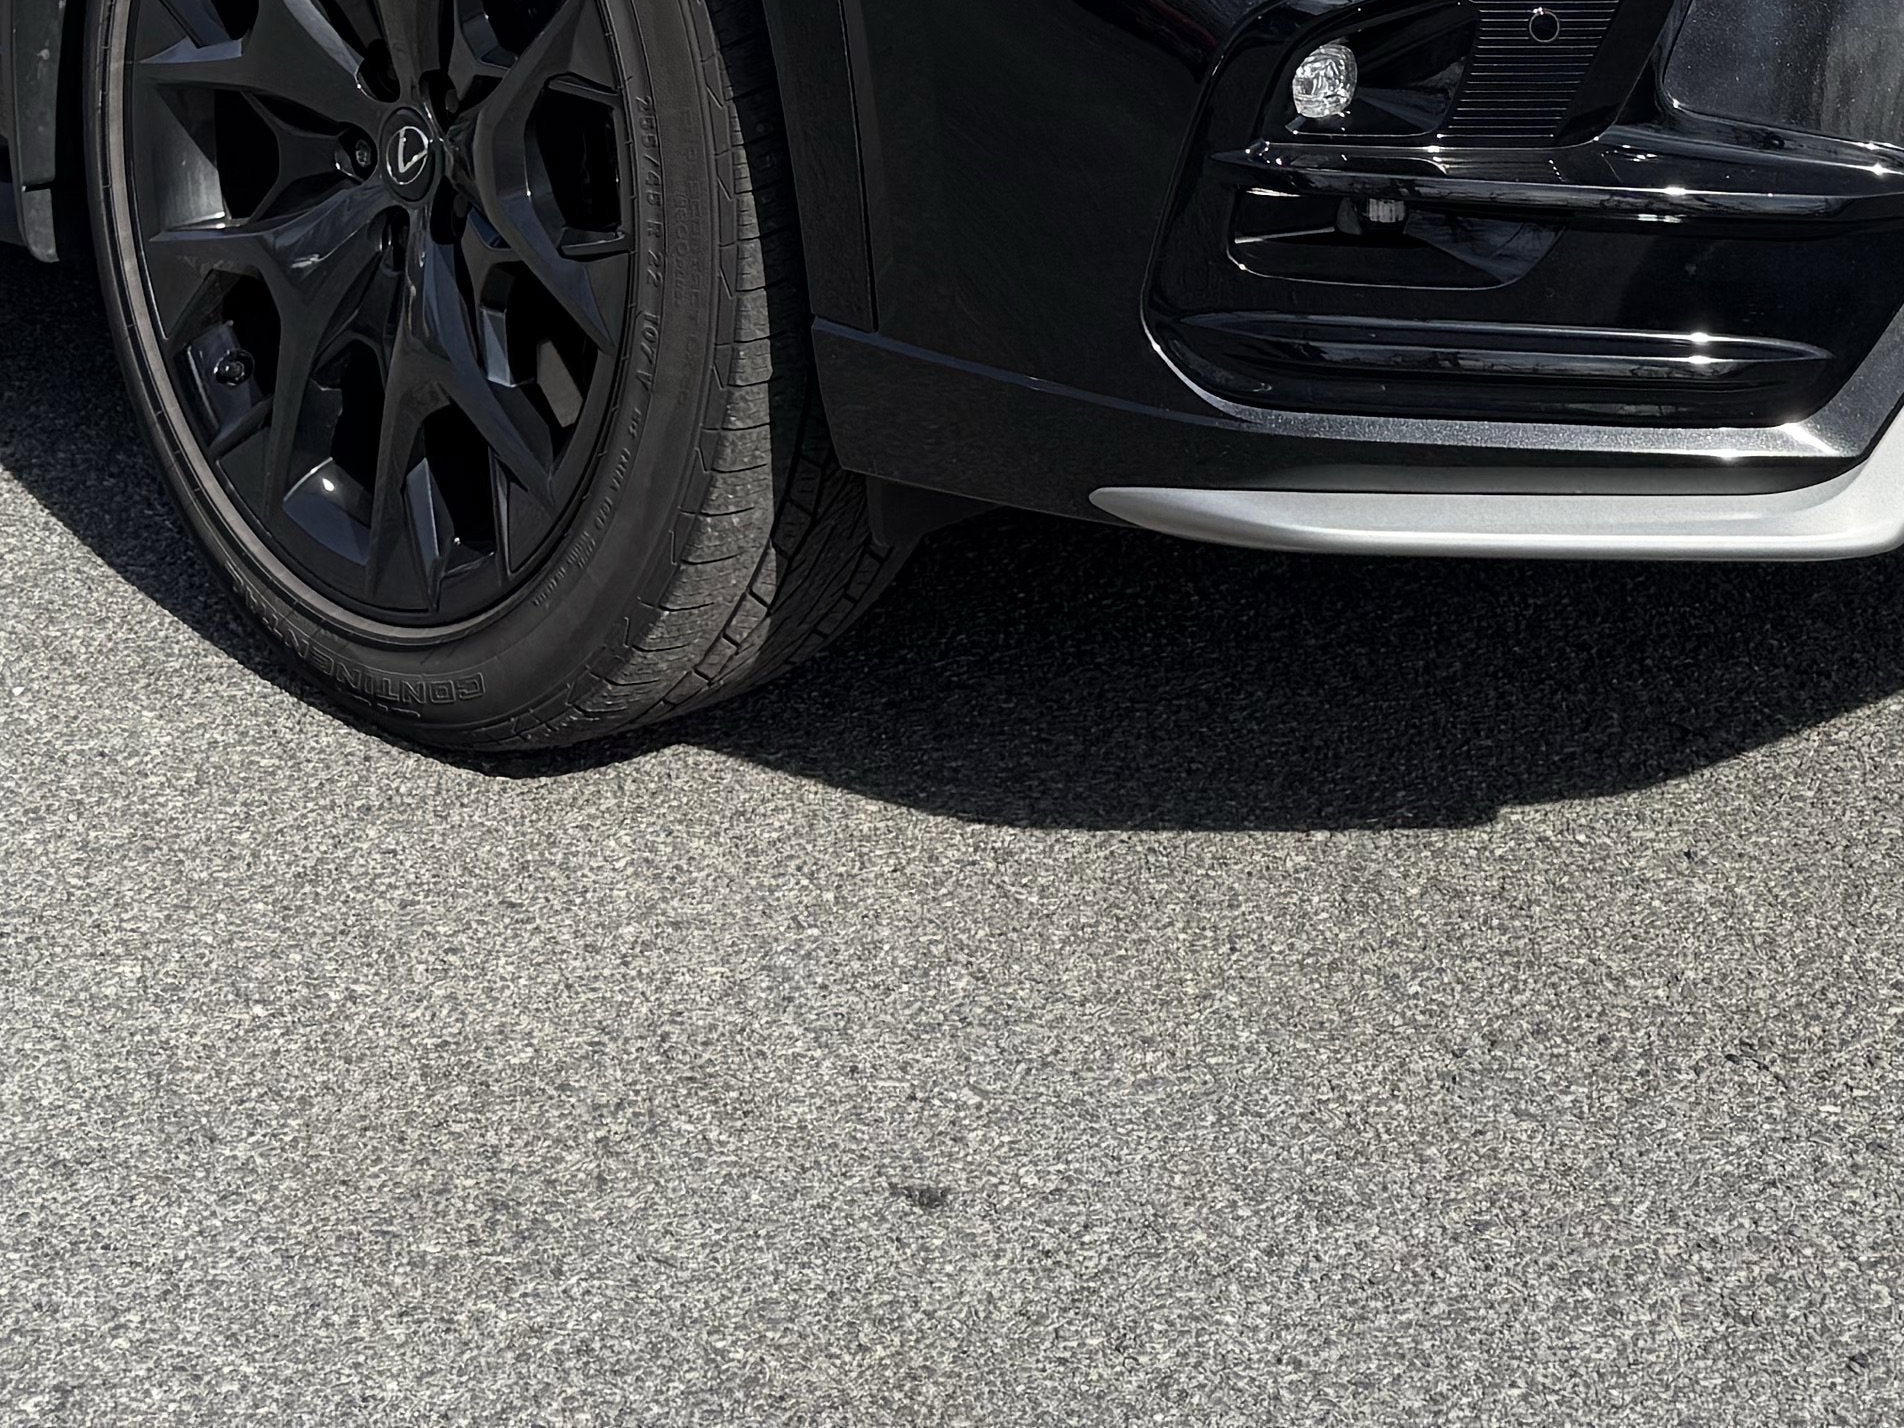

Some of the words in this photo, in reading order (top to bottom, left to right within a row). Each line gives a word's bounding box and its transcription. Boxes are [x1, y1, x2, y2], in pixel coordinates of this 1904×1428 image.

[646, 248, 664, 290] 22
[640, 311, 660, 364] 107
[226, 561, 487, 702] CONTINENTAL
